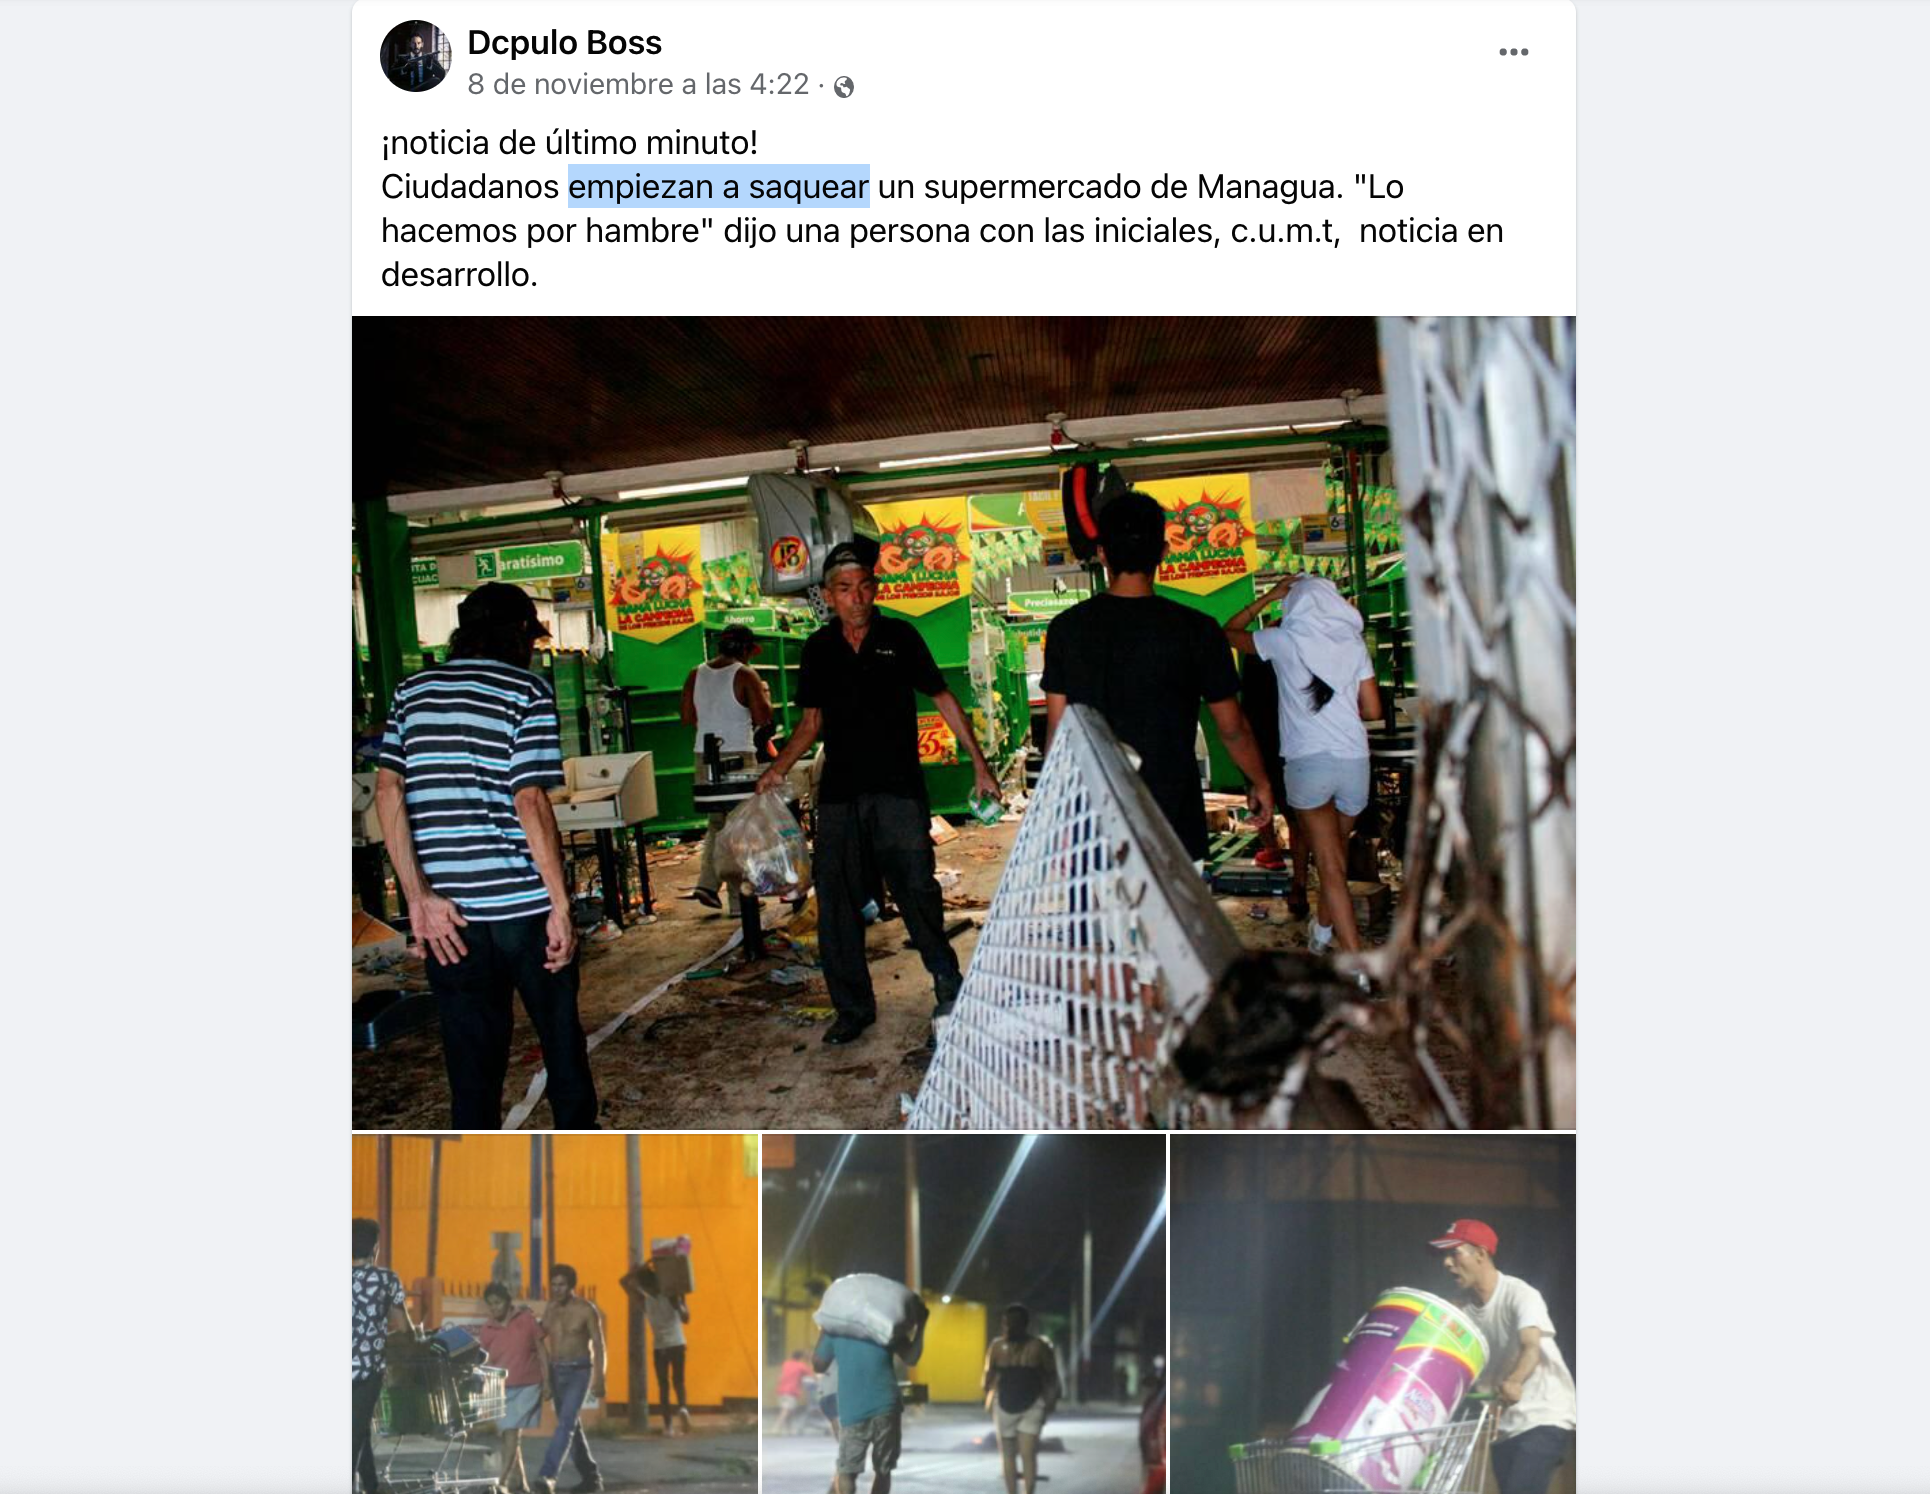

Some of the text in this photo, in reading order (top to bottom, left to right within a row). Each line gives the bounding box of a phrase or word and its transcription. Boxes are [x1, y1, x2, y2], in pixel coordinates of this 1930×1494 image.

[469, 28, 662, 61] Dcpulo Boss
[468, 72, 810, 95] 8 de noviembre a las 4:22
[383, 127, 757, 161] ¡noticia de último minuto!
[382, 172, 1404, 205] Ciudadanos empiezan a saquear un supermercado de Managua. "Lo
[382, 216, 1503, 249] hacemos por hambre" dijo una persona con las iniciales, c.u.m.t, noticia en
[381, 260, 537, 287] desarrollo.
[1159, 563, 1175, 575] LA
